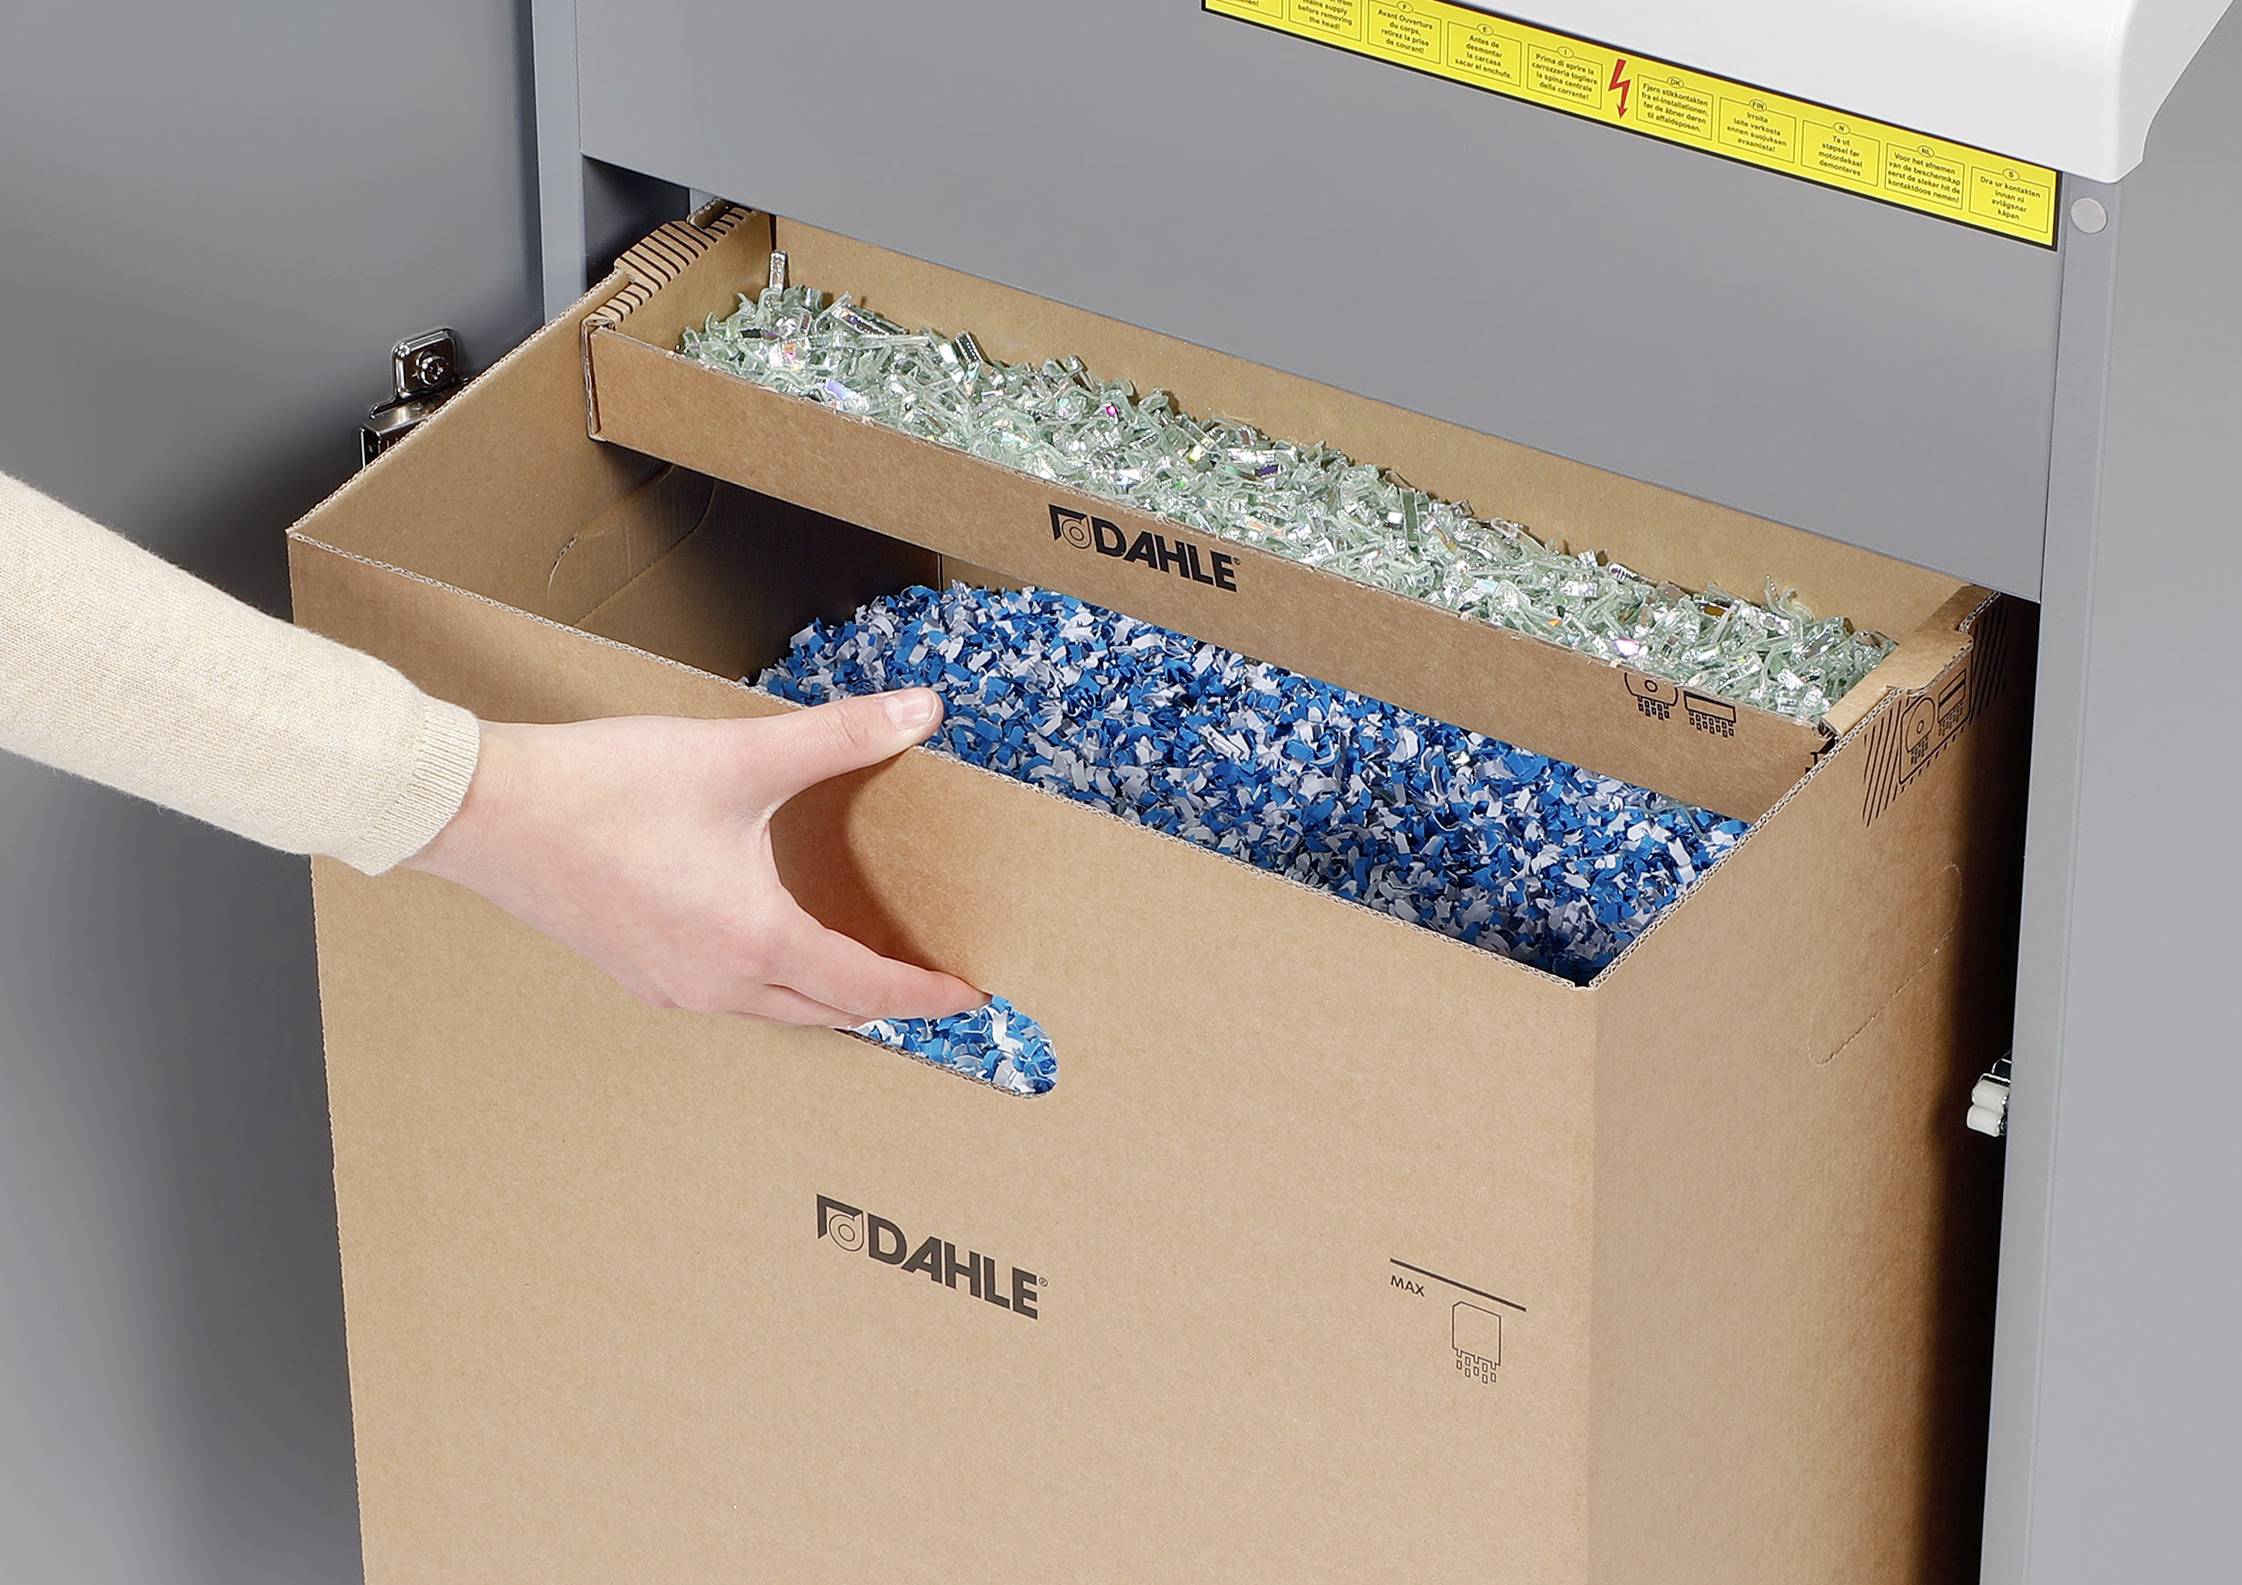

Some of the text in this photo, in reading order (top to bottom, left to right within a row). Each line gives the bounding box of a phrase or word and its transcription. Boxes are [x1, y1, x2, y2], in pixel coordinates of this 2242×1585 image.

[1297, 4, 1353, 26] before removing
[1325, 4, 1347, 15] supply
[1309, 16, 1340, 30] the head!
[1378, 9, 1433, 29] Avant Ouverture
[1389, 21, 1398, 29] du
[1381, 28, 1402, 40] retirez
[1412, 37, 1429, 47] prise
[1385, 38, 1394, 46] de
[1469, 35, 1489, 46] Antes
[1466, 43, 1503, 57] desmontar
[1455, 58, 1474, 67] sacar
[1467, 51, 1501, 67] la carcasa
[1536, 53, 1556, 64] Prima
[1557, 59, 1564, 67] di
[1566, 63, 1586, 73] aprire
[1531, 62, 1597, 85] carrozzeria togliere
[1539, 81, 1556, 91] della
[1544, 74, 1563, 84] spina
[1565, 80, 1592, 92] centrale
[1642, 92, 1651, 100] fra
[1643, 83, 1708, 106] Fjern stikkontakten
[1752, 101, 1764, 110] FIN
[1727, 126, 1787, 146] ennen suojuksen
[1750, 123, 1781, 136] verkosta
[1833, 135, 1841, 144] Ta
[1818, 151, 1863, 168] motordeksel
[1894, 152, 1956, 175] Voor het afnemen
[1819, 160, 1861, 176] demonteres
[1888, 161, 1901, 169] van
[1913, 167, 1961, 186] beschermkap
[1887, 170, 1906, 179] eerst
[1951, 186, 1960, 194] de
[1979, 176, 1993, 185] Dra
[2005, 183, 2041, 198] kontakten
[1888, 178, 1959, 203] kontaktdoos nemen!
[1995, 190, 2016, 201] innan
[1390, 1275, 1425, 1297] MAX
